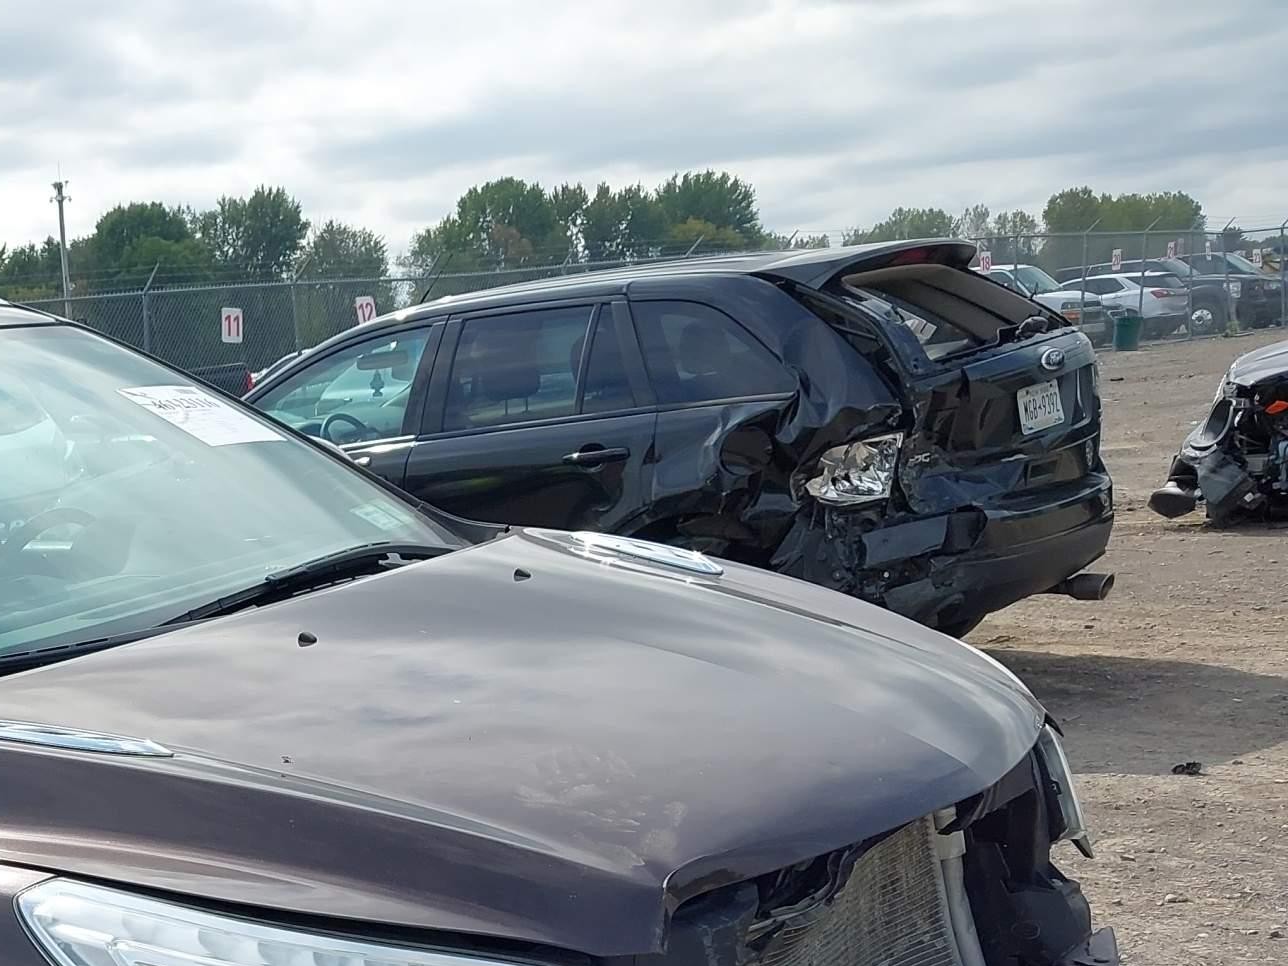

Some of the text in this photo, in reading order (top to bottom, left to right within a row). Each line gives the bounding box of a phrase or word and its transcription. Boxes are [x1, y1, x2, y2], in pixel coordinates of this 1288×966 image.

[981, 256, 991, 272] 18
[358, 302, 373, 322] 12
[224, 314, 240, 337] 11
